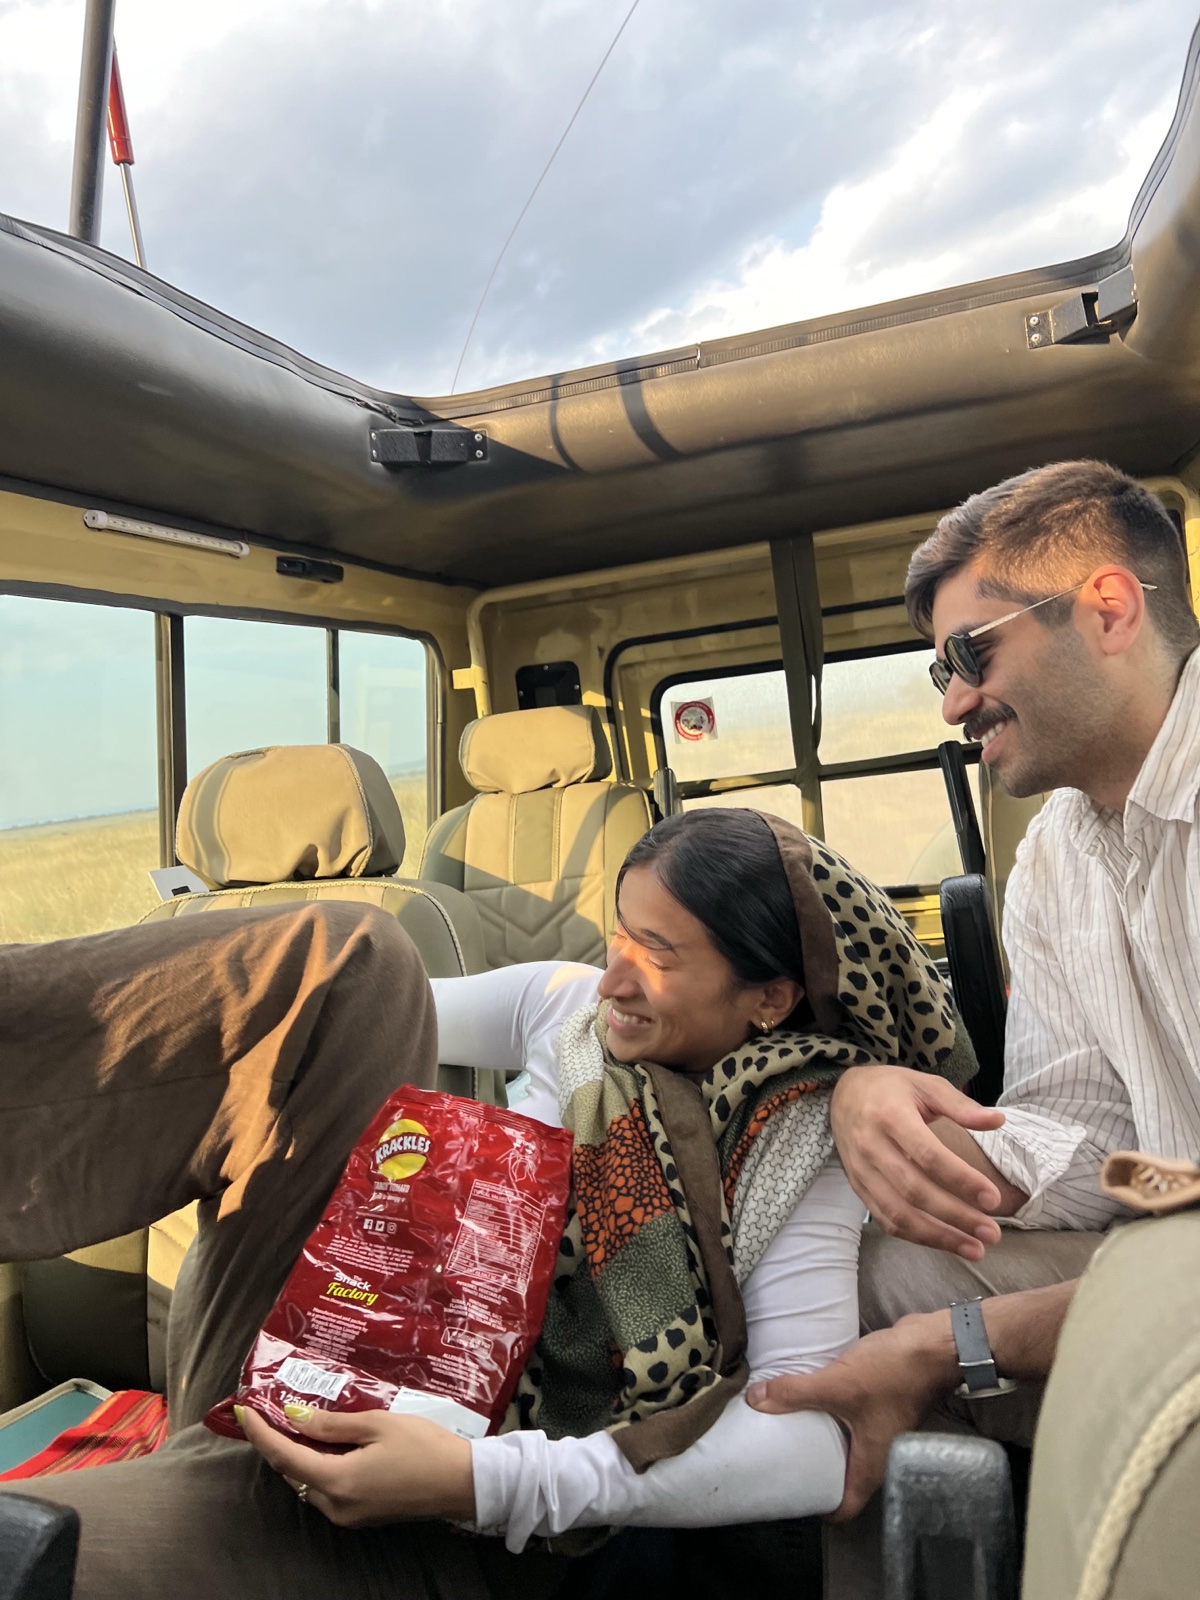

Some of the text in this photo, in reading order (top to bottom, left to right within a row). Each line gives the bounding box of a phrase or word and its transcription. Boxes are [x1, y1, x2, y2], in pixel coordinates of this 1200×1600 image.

[375, 1135, 431, 1164] KRACKLES
[333, 1272, 372, 1291] Snack
[326, 1282, 379, 1306] Factory
